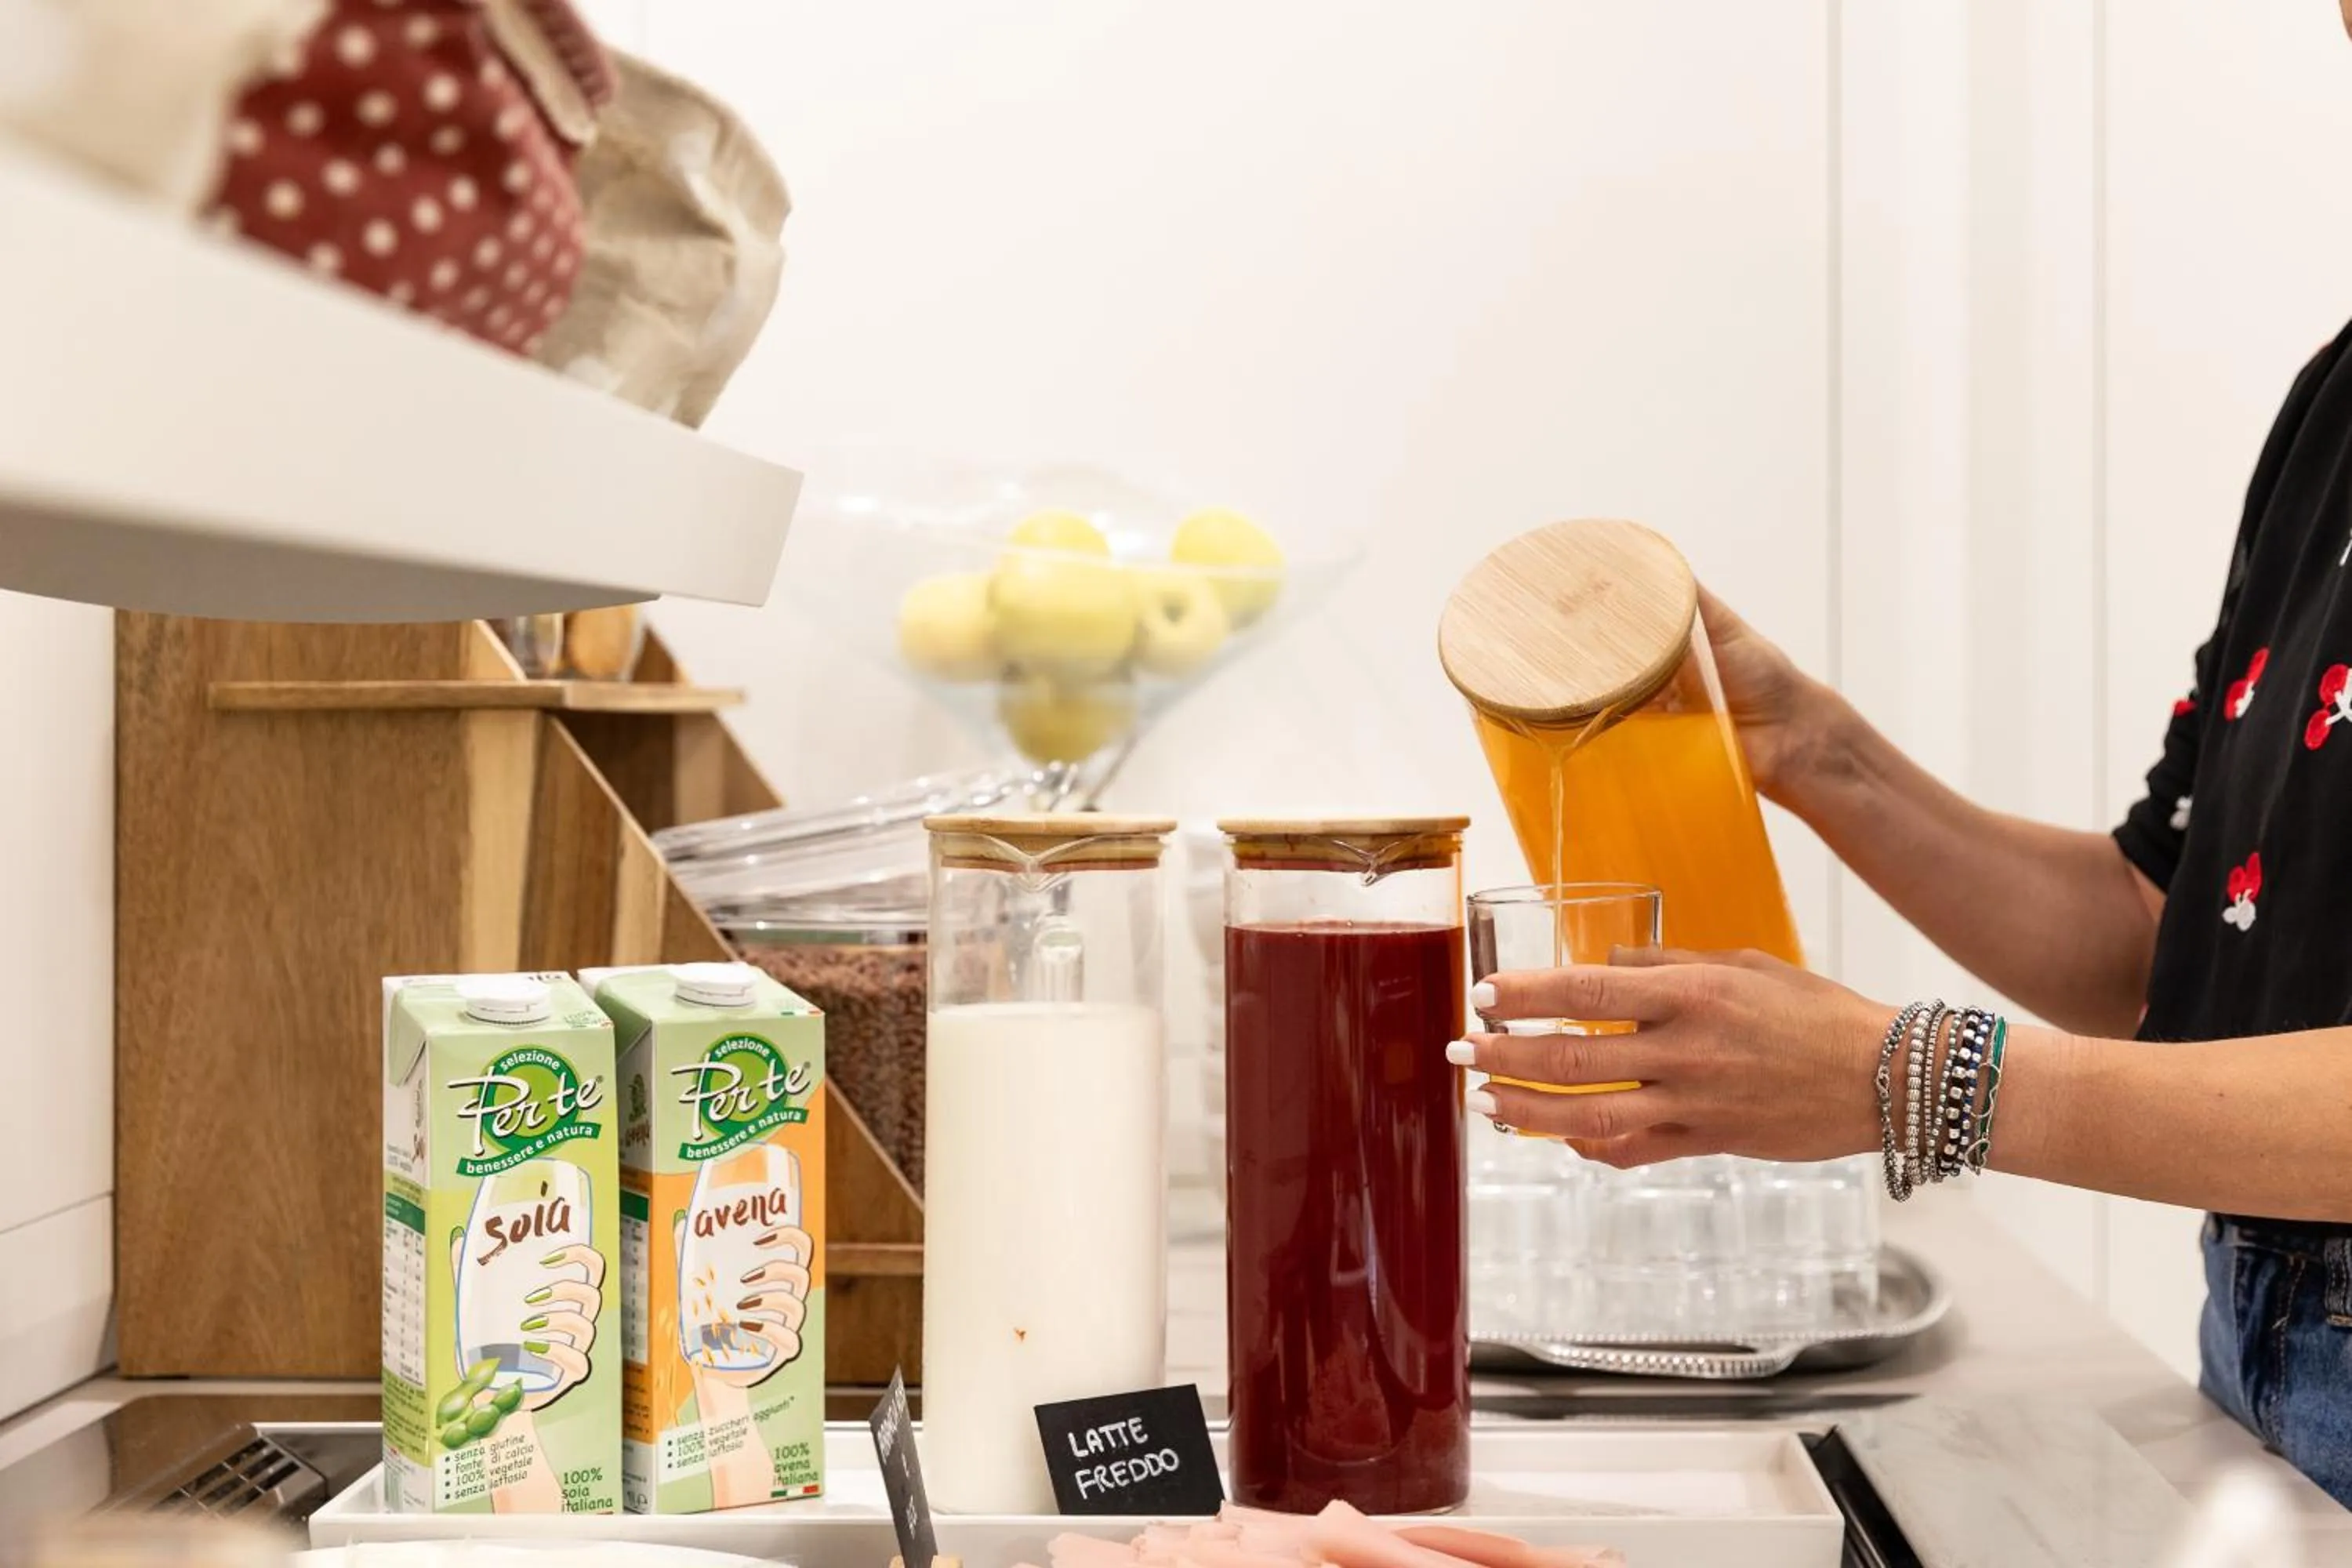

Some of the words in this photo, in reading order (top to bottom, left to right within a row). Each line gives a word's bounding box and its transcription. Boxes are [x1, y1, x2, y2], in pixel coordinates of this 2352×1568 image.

[500, 1050, 560, 1071] selezione
[714, 1037, 771, 1058] selezione
[448, 1065, 546, 1156] Per
[670, 1053, 759, 1142] Per
[466, 1145, 534, 1174] benessere
[535, 1138, 545, 1149] e
[546, 1124, 593, 1145] natura
[687, 1131, 747, 1159] benessere
[748, 1124, 757, 1134] e
[758, 1110, 801, 1129] natura
[477, 1181, 571, 1265] soia
[695, 1187, 787, 1238] avena
[454, 1446, 485, 1462] senza
[775, 1442, 810, 1459] 100%
[1068, 1417, 1149, 1457] LATTE
[457, 1468, 485, 1486] 100%
[489, 1456, 533, 1476] vegetale
[564, 1467, 603, 1484] 100%
[1075, 1448, 1180, 1500] FREDDO
[455, 1484, 485, 1500] senza
[561, 1497, 613, 1513] italiana
